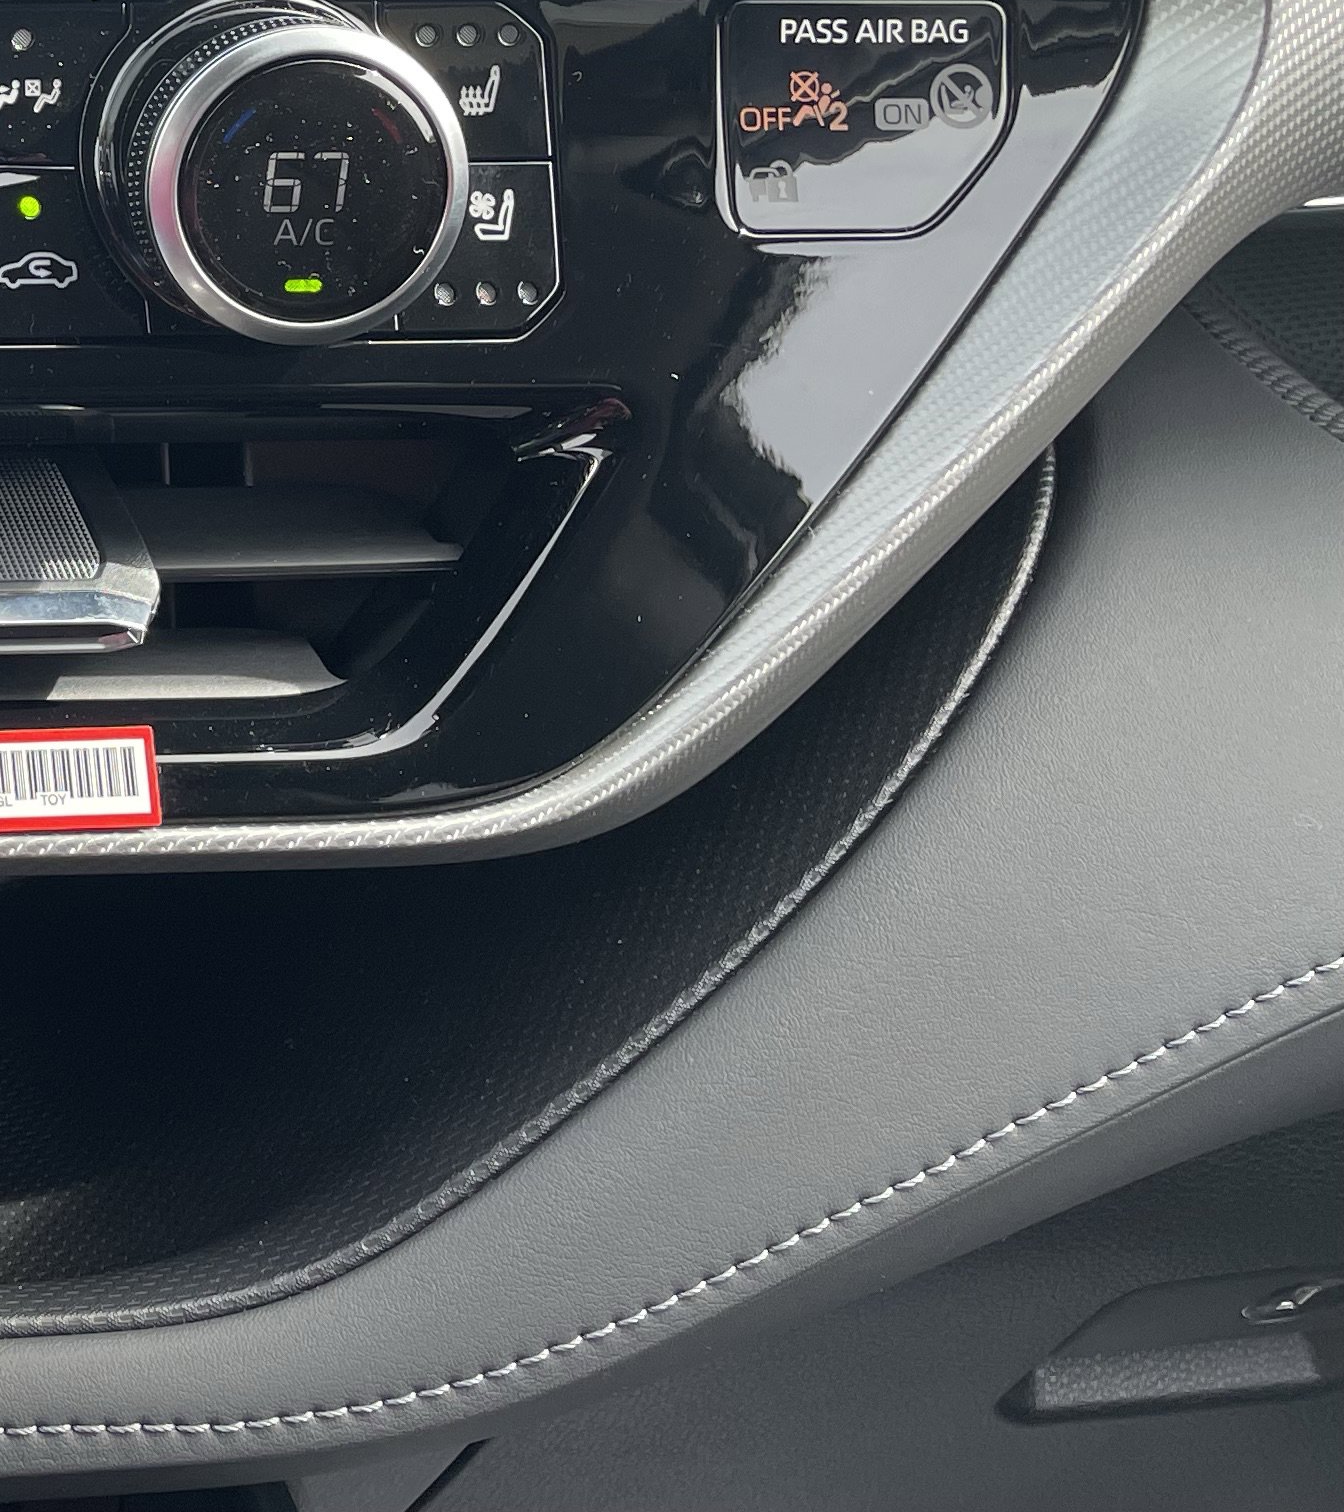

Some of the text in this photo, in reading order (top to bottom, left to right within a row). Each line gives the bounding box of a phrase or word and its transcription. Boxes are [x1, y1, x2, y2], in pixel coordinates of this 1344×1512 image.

[780, 18, 969, 44] PASS AIR BAG
[740, 106, 791, 131] OFF
[883, 103, 922, 125] ON
[262, 152, 350, 213] 67
[274, 218, 334, 247] A/C
[41, 793, 67, 806] TOY
